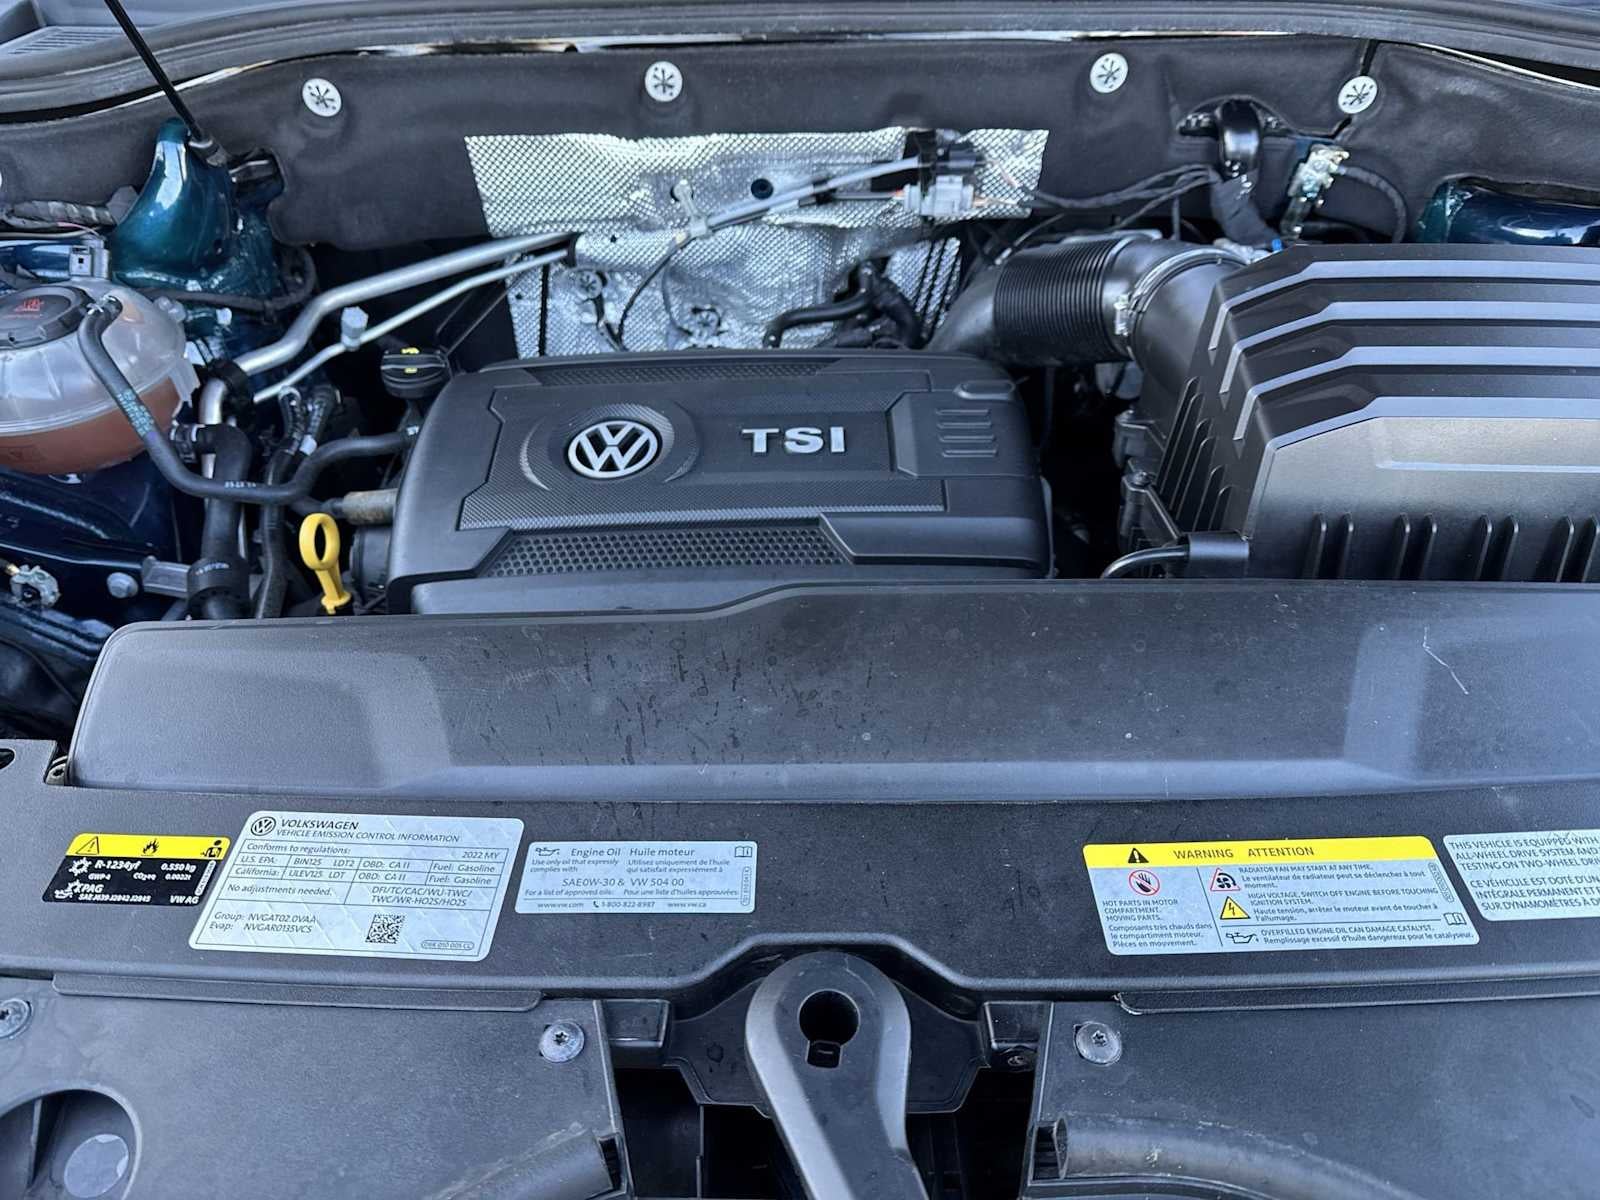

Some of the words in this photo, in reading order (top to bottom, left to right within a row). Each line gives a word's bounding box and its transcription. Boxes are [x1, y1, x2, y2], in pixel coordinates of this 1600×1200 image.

[741, 425, 846, 454] TSI
[281, 818, 359, 830] VOLKSWAGEN
[276, 829, 312, 838] VEHICLE
[313, 831, 354, 839] EMISSION
[355, 832, 396, 841] CONTROL
[397, 833, 460, 843] INFORMATION
[1448, 841, 1472, 850] THIS
[1472, 839, 1511, 849] VEHICLE
[1512, 839, 1523, 847] IS
[1524, 837, 1571, 847] EQUIPPED
[1572, 836, 1599, 845] WITH
[247, 842, 288, 852] Conforms
[289, 844, 299, 852] to
[300, 844, 352, 855] regulations:
[571, 847, 605, 858] Engine
[606, 847, 621, 857] Oil
[629, 847, 656, 857] Huile
[657, 848, 696, 857] moteur
[1172, 848, 1234, 859] WARNING
[1248, 846, 1315, 857] ATTENTION
[461, 851, 483, 859] 2022
[1455, 850, 1510, 861] ALL-WHEEL
[1509, 849, 1539, 859] DRIVE
[1541, 848, 1576, 857] SYSTEM
[1577, 847, 1599, 856] AND
[240, 855, 256, 863] U.S.
[257, 856, 278, 864] EPA:
[293, 857, 322, 866] BIN125
[333, 859, 355, 868] LDT2
[362, 860, 385, 868] OBD:
[388, 860, 402, 869] CA
[402, 861, 411, 869] II
[1460, 861, 1501, 871] TESTING
[1501, 860, 1520, 870] ON
[1520, 858, 1581, 869] TWO-WHEEL
[94, 859, 142, 871] R-1234yf
[160, 862, 185, 871] 0.550
[185, 863, 197, 873] kg
[433, 863, 454, 871] Fuel:
[457, 864, 496, 873] Gasoline
[1239, 866, 1274, 874] RADIATOR
[234, 867, 280, 877] California:
[288, 870, 323, 878] ULEV125
[328, 871, 347, 879] LDT
[358, 872, 381, 880] OBD:
[384, 873, 398, 881] CA
[399, 873, 407, 881] II
[1336, 873, 1354, 881] peut
[429, 875, 450, 884] Fuel:
[454, 876, 492, 885] Gasoline
[616, 877, 625, 887] &
[630, 877, 649, 887] VW
[650, 877, 669, 887] 504
[671, 877, 685, 887] 00
[1469, 878, 1484, 889] CE
[1531, 876, 1547, 886] EST
[81, 883, 104, 893] PAG
[227, 883, 241, 892] No
[241, 884, 297, 895] adjustments
[297, 887, 333, 896] needed.
[1300, 890, 1330, 898] SWITCH
[1372, 888, 1401, 896] BEFORE
[1401, 887, 1439, 895] TOUCHING
[1526, 886, 1585, 898] PERMANENT
[1584, 886, 1597, 896] ET
[170, 895, 186, 904] VW
[185, 895, 200, 904] AG
[1283, 898, 1314, 906] SYSTEM.
[1480, 900, 1503, 911] SUR
[214, 911, 244, 922] Group:
[1253, 907, 1277, 915] Haute
[1277, 907, 1308, 916] tension,
[1106, 914, 1137, 922] MOVING
[209, 922, 234, 932] Evap:
[1108, 924, 1153, 932] Composants
[1153, 923, 1168, 931] très
[1195, 922, 1213, 930] dans
[1260, 927, 1306, 936] OVERFILLED
[1306, 927, 1335, 935] ENGINE
[1335, 926, 1348, 934] OIL
[1348, 926, 1365, 934] CAN
[1365, 925, 1397, 933] DAMAGE
[1119, 932, 1174, 941] compartiment
[1263, 935, 1311, 944] Remplissage
[1367, 934, 1407, 943] dangereux
[1149, 940, 1198, 948] mouvement.
